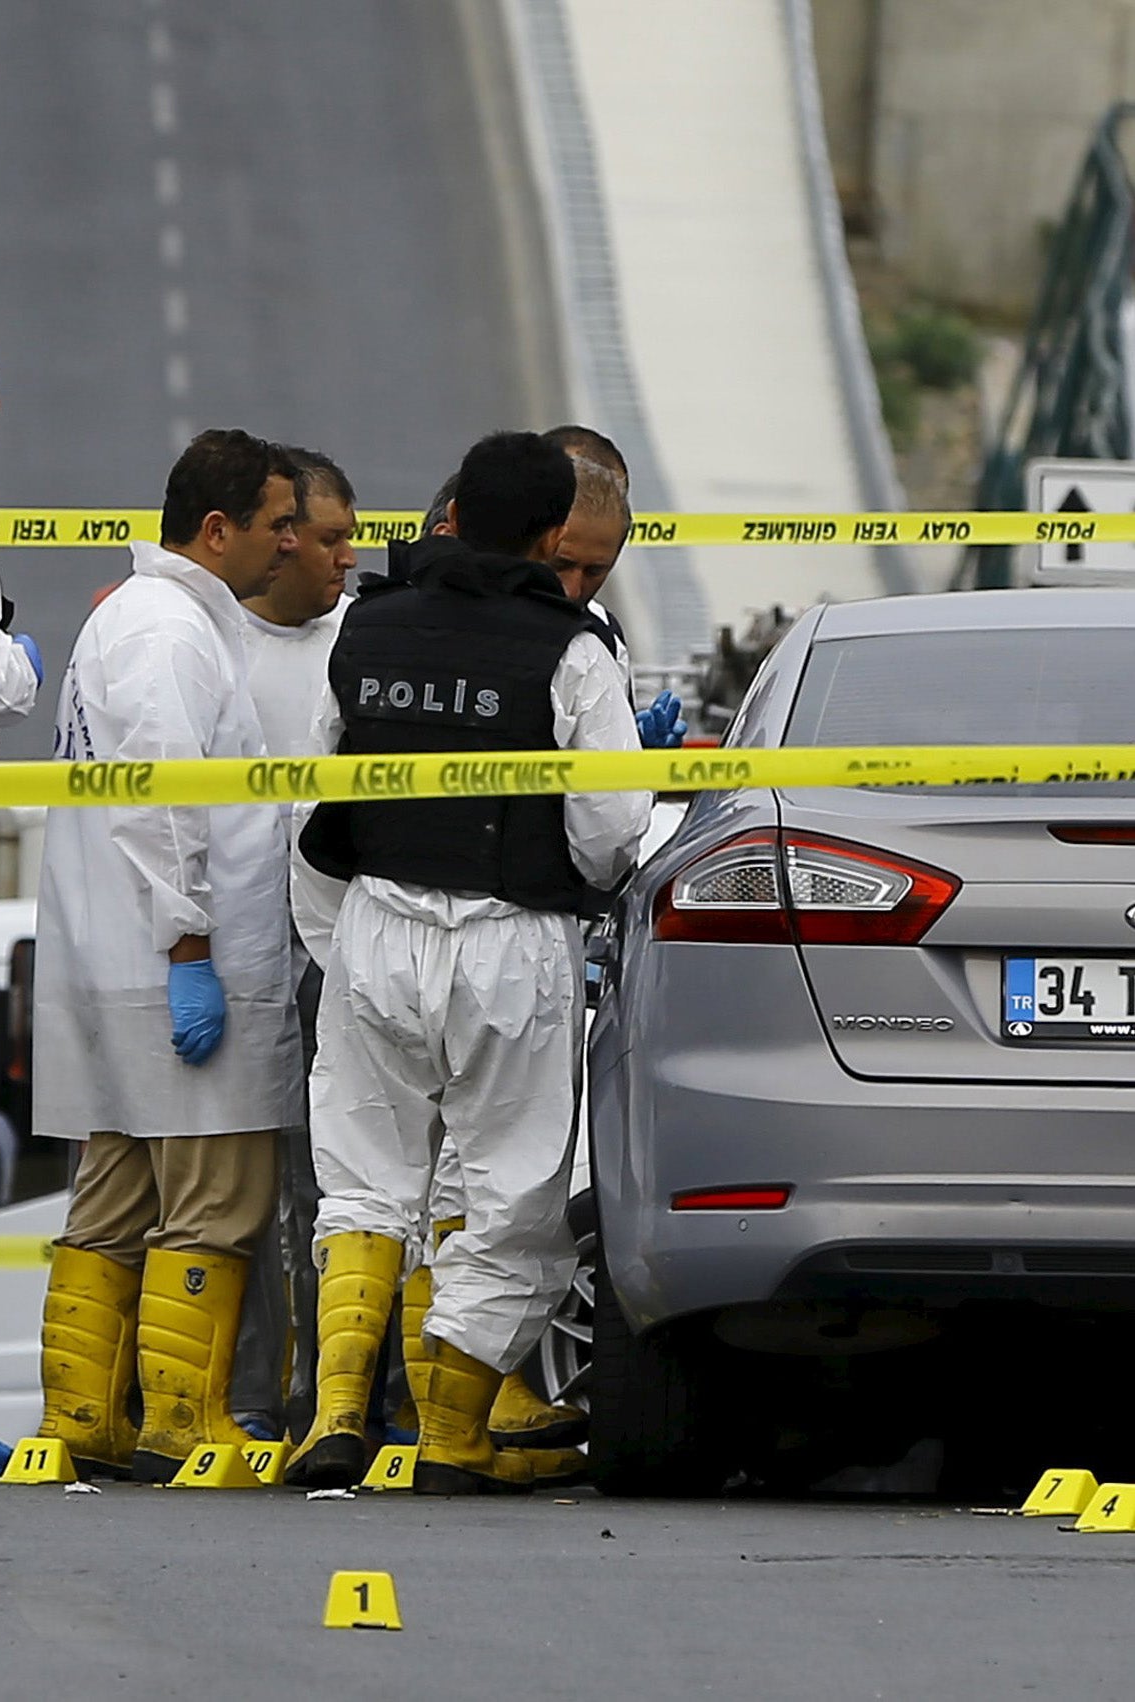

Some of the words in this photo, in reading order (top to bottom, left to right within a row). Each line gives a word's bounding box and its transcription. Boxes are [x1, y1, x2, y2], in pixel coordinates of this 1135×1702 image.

[79, 520, 130, 541] OLAY
[630, 522, 676, 542] POLİ
[920, 522, 971, 541] OLAY
[1036, 522, 1095, 543] POLİS
[359, 678, 500, 717] POLİS
[1038, 966, 1096, 1016] 34
[1011, 995, 1033, 1010] TR
[833, 1015, 955, 1031] MONDEO
[23, 1449, 48, 1470] 11
[194, 1451, 217, 1476] 9
[386, 1456, 404, 1478] 8
[1044, 1477, 1064, 1500] 7
[1101, 1494, 1120, 1518] 4
[353, 1582, 370, 1612] 1
